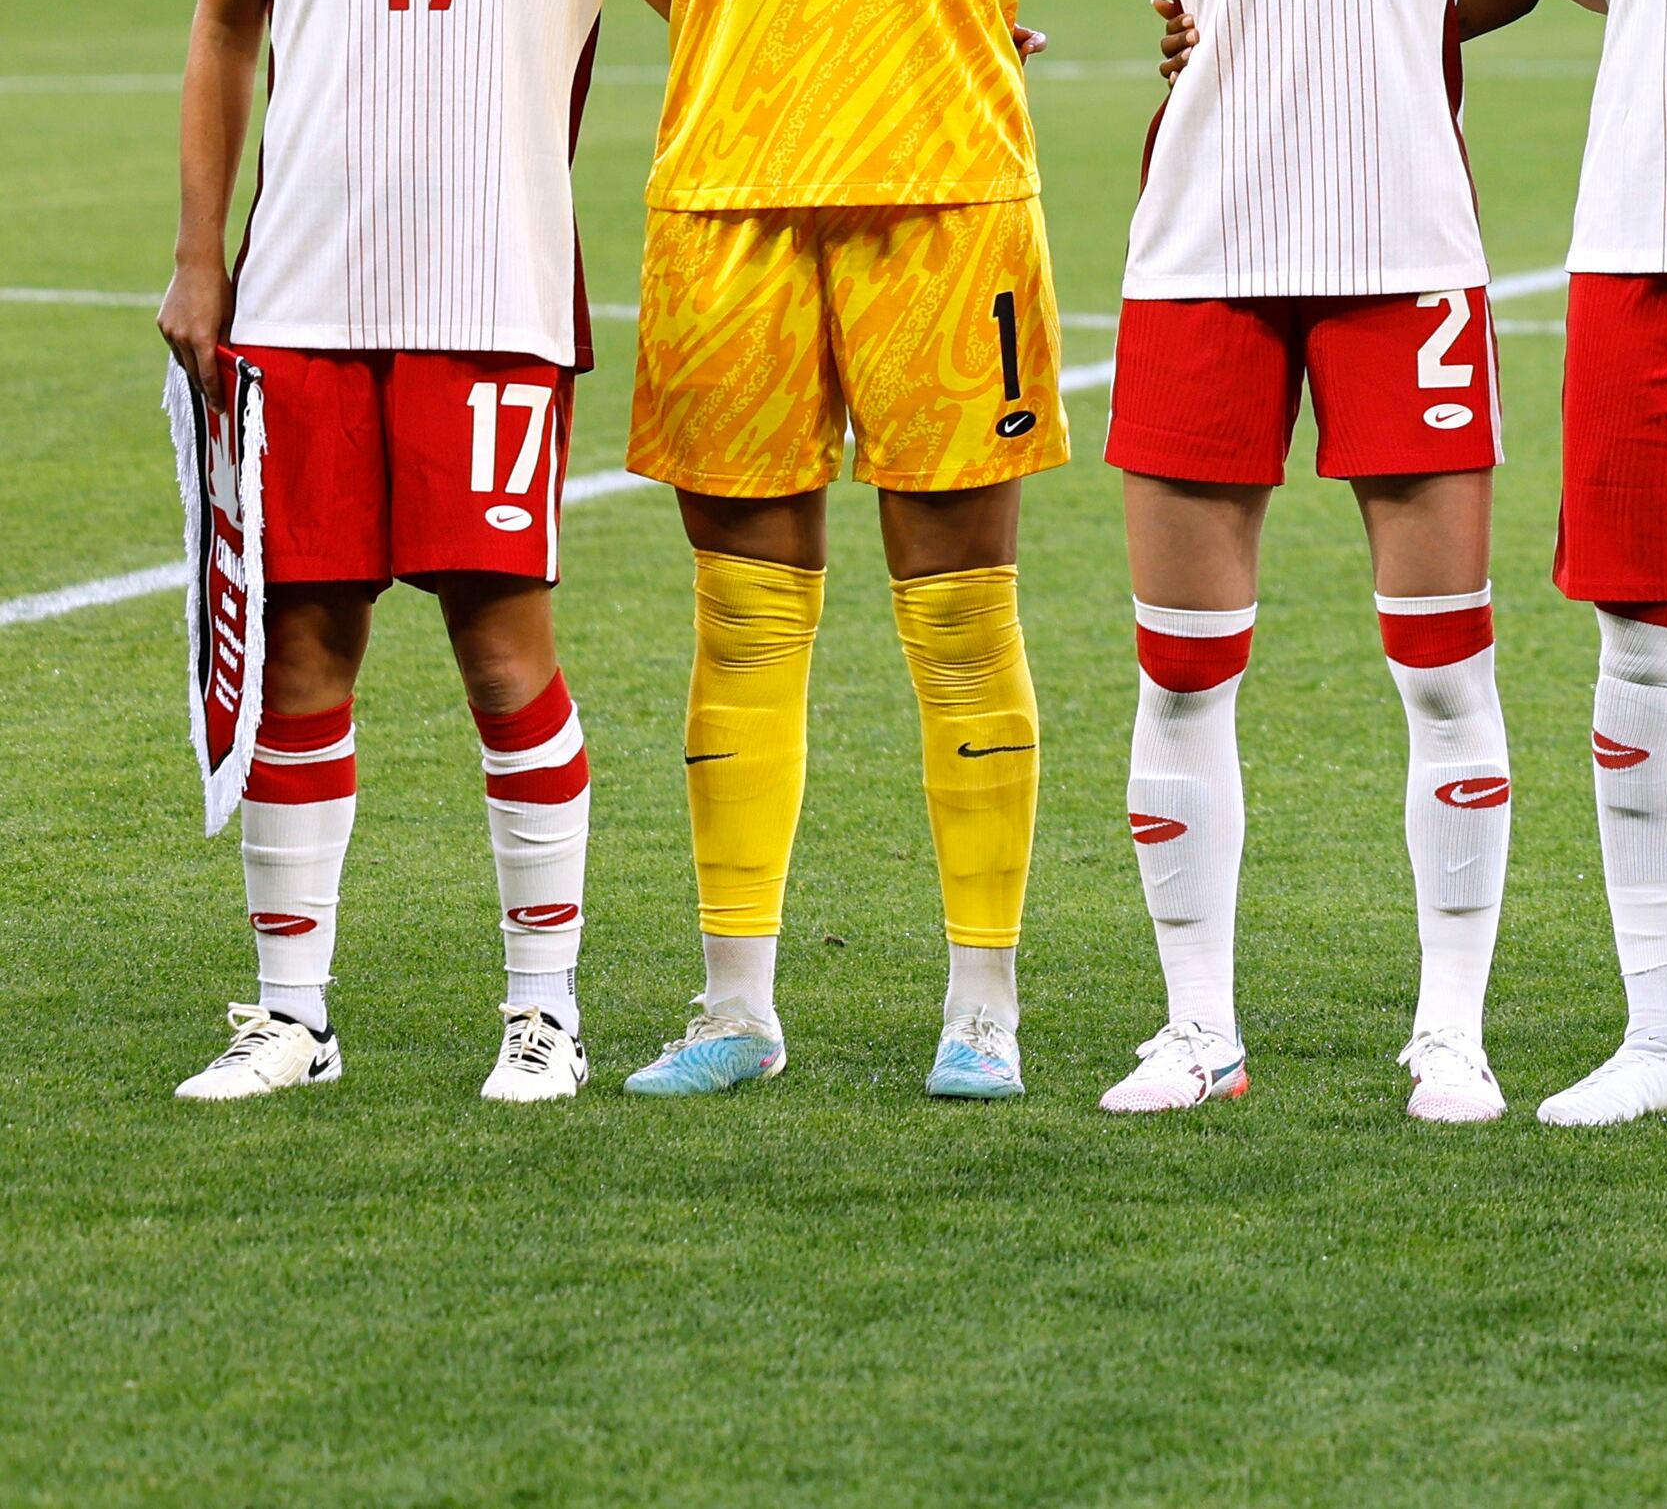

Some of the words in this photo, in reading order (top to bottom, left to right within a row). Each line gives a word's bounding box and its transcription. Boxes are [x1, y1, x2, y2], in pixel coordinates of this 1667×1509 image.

[992, 291, 1021, 401] 1
[1416, 289, 1474, 389] 2
[466, 382, 553, 494] 17
